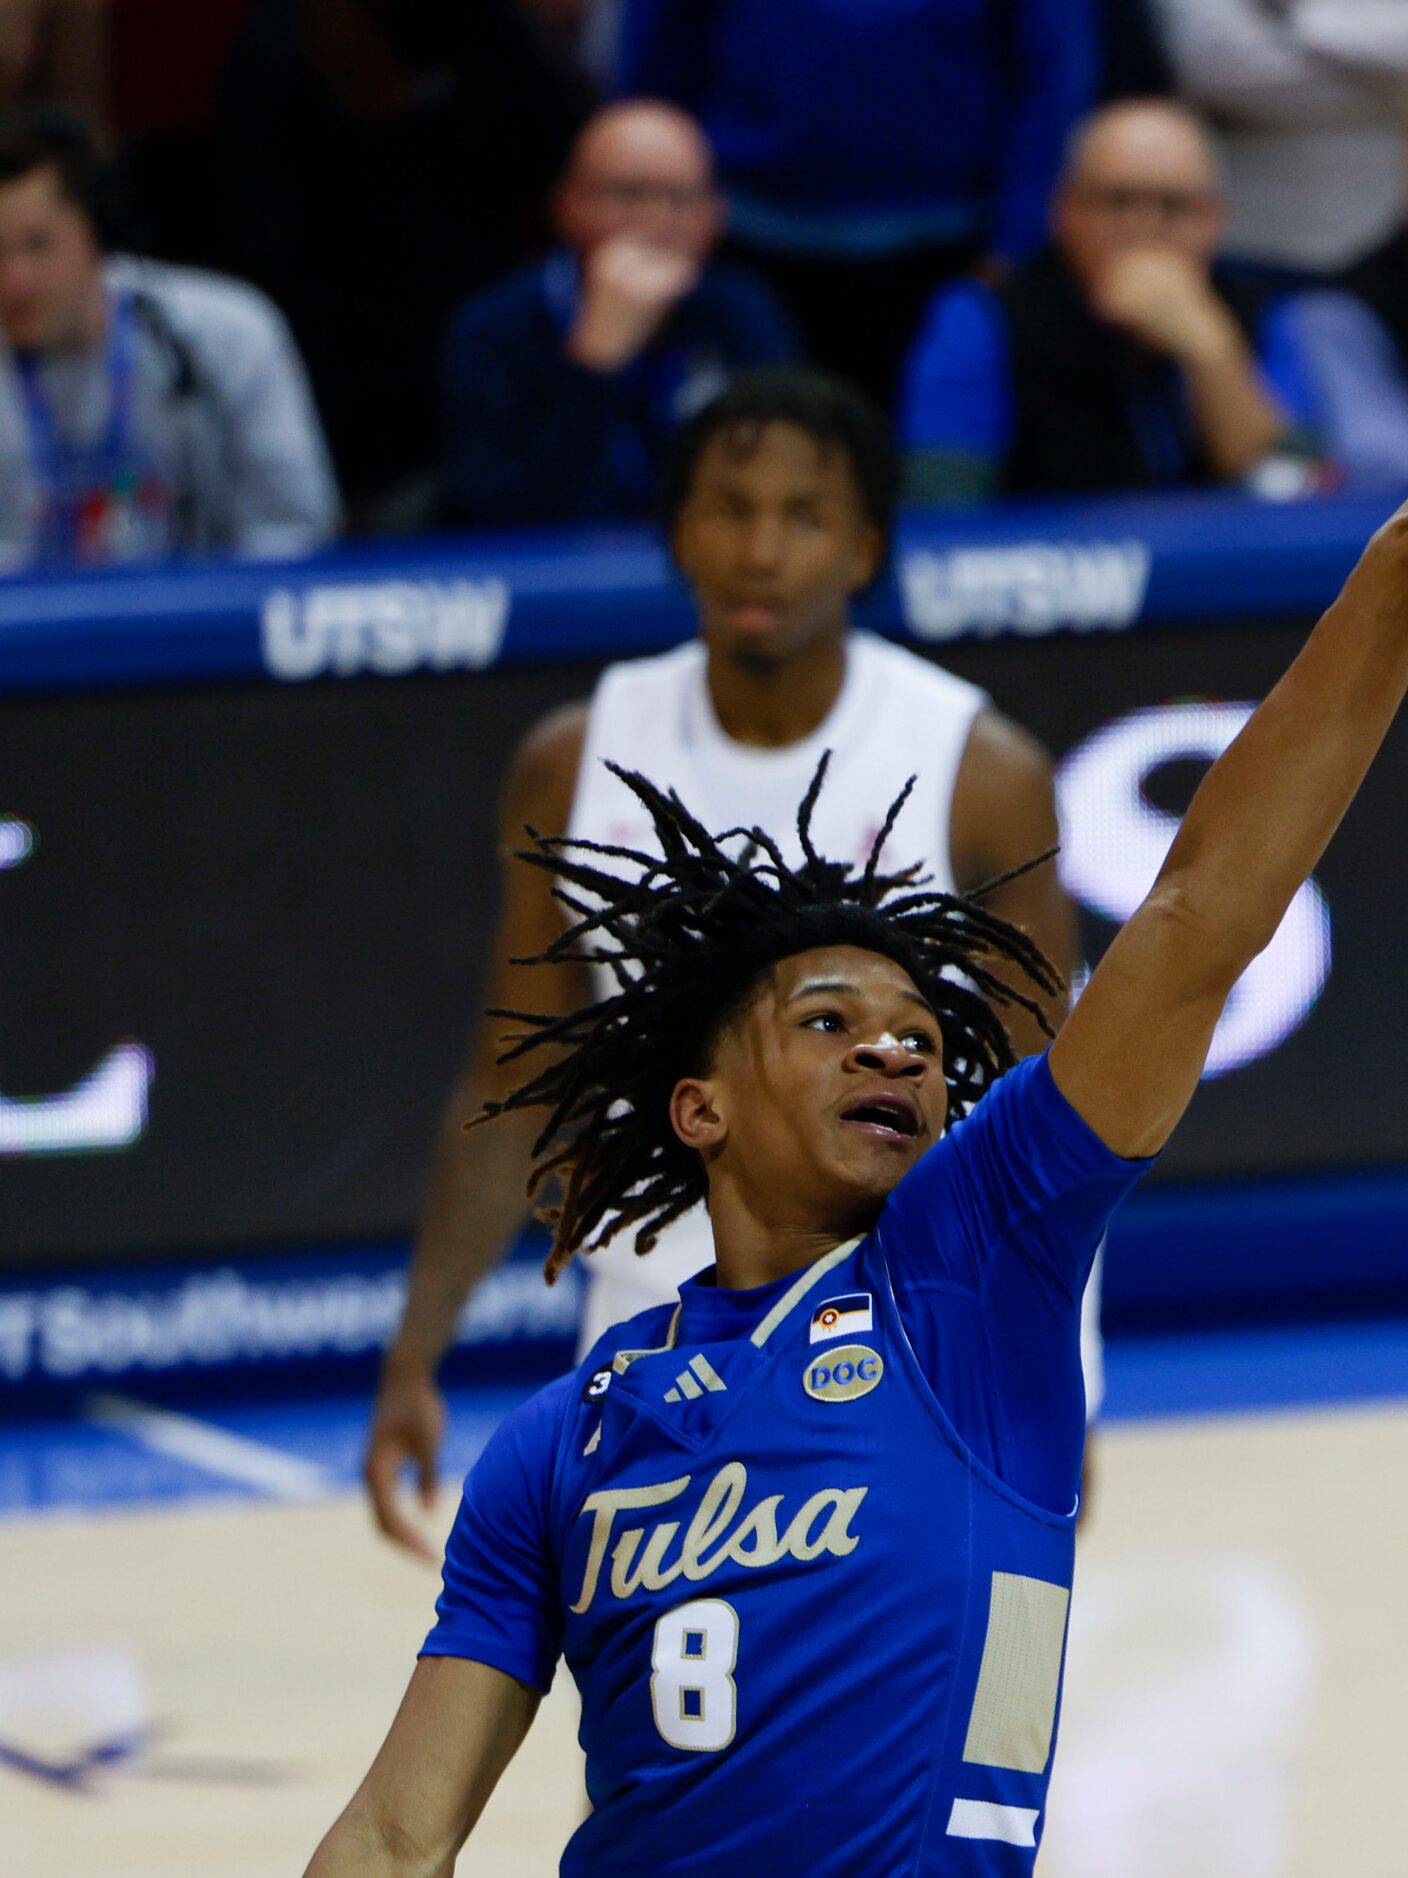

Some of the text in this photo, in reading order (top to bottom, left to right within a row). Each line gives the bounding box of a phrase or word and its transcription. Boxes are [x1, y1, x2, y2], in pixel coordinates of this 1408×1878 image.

[262, 580, 508, 681] UTSW
[902, 542, 1149, 640] UTSW
[589, 1371, 612, 1395] 3
[811, 1357, 877, 1390] DOC
[569, 1461, 868, 1614] Tulsa
[650, 1598, 740, 1752] 8
